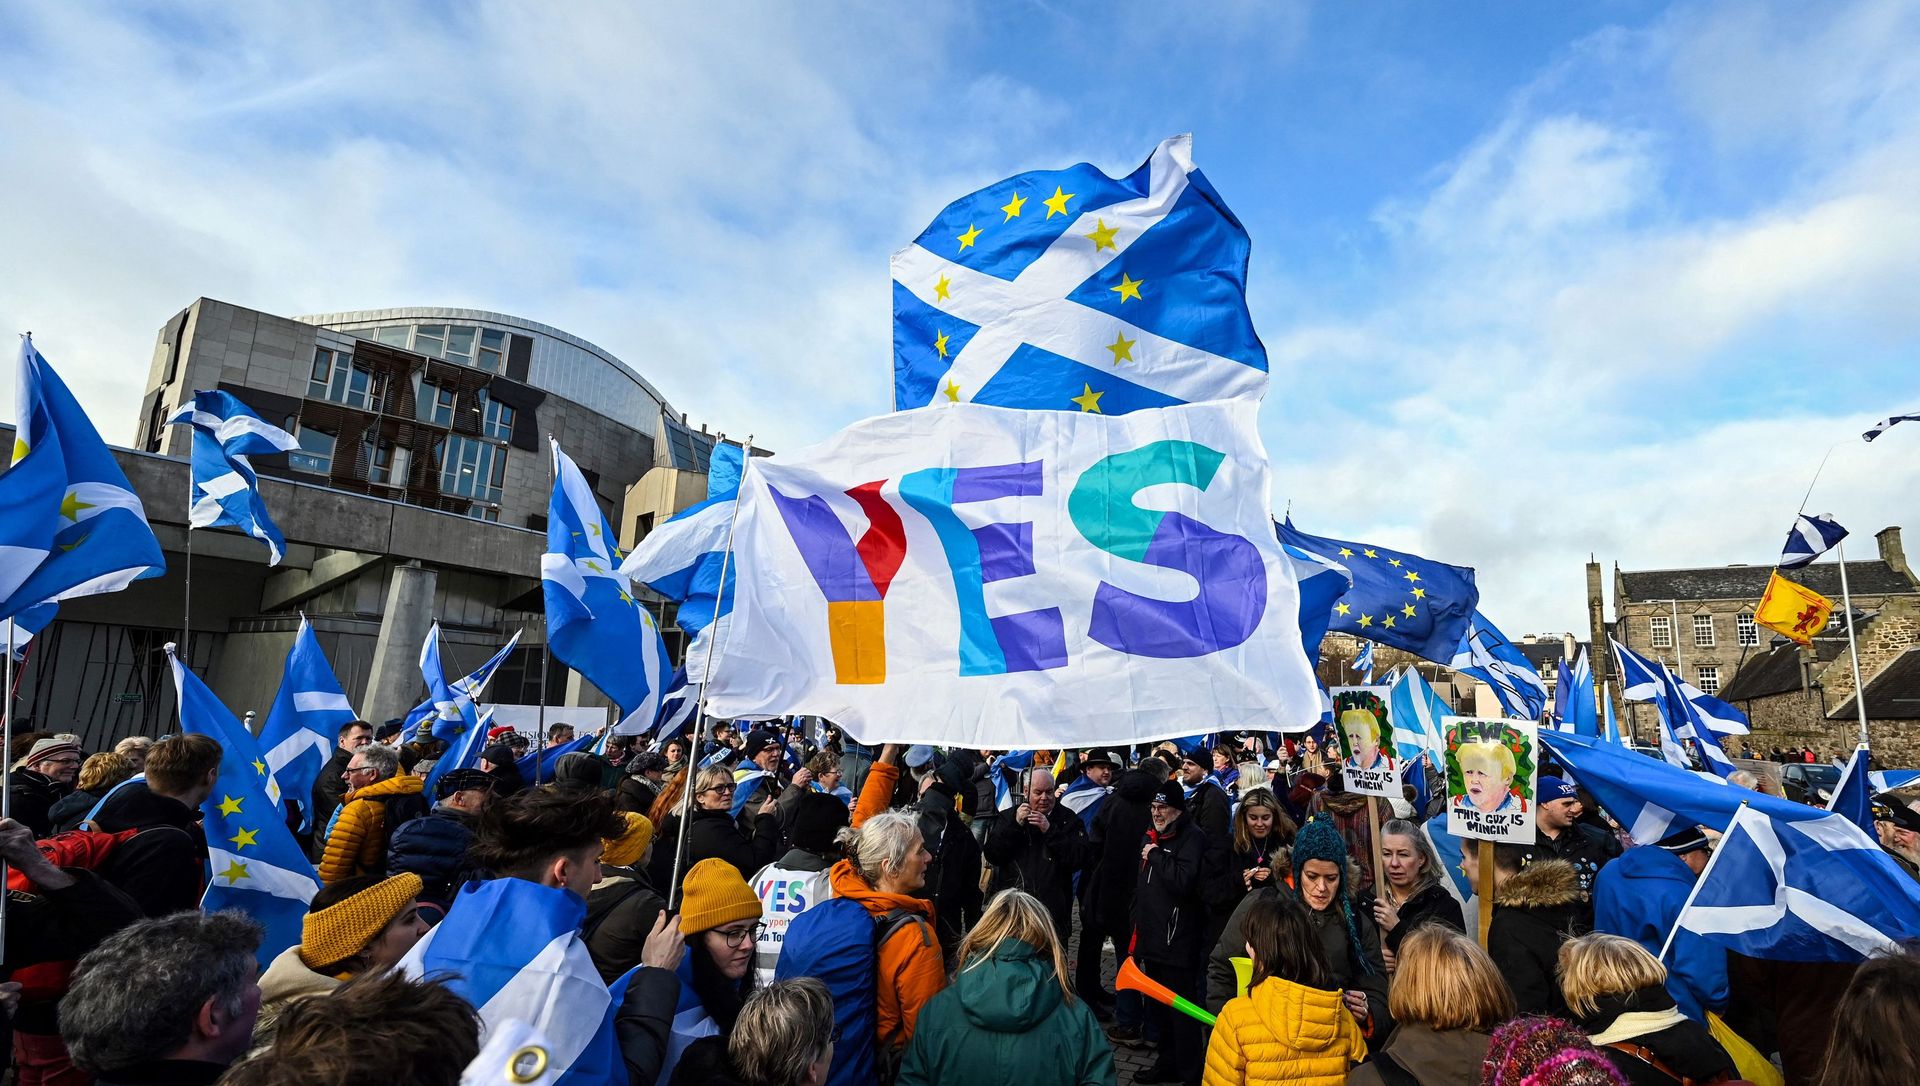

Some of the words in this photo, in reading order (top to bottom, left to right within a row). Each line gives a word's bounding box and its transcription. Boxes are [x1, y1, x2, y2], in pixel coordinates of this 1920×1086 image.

[766, 440, 1267, 685] YES
[1346, 768, 1362, 778] THIS
[1364, 772, 1380, 780] GUY
[1383, 772, 1393, 783] IS
[1454, 808, 1480, 821] THIS
[1486, 814, 1507, 824] GUY
[1511, 814, 1524, 826] IS
[759, 880, 806, 913] YES
